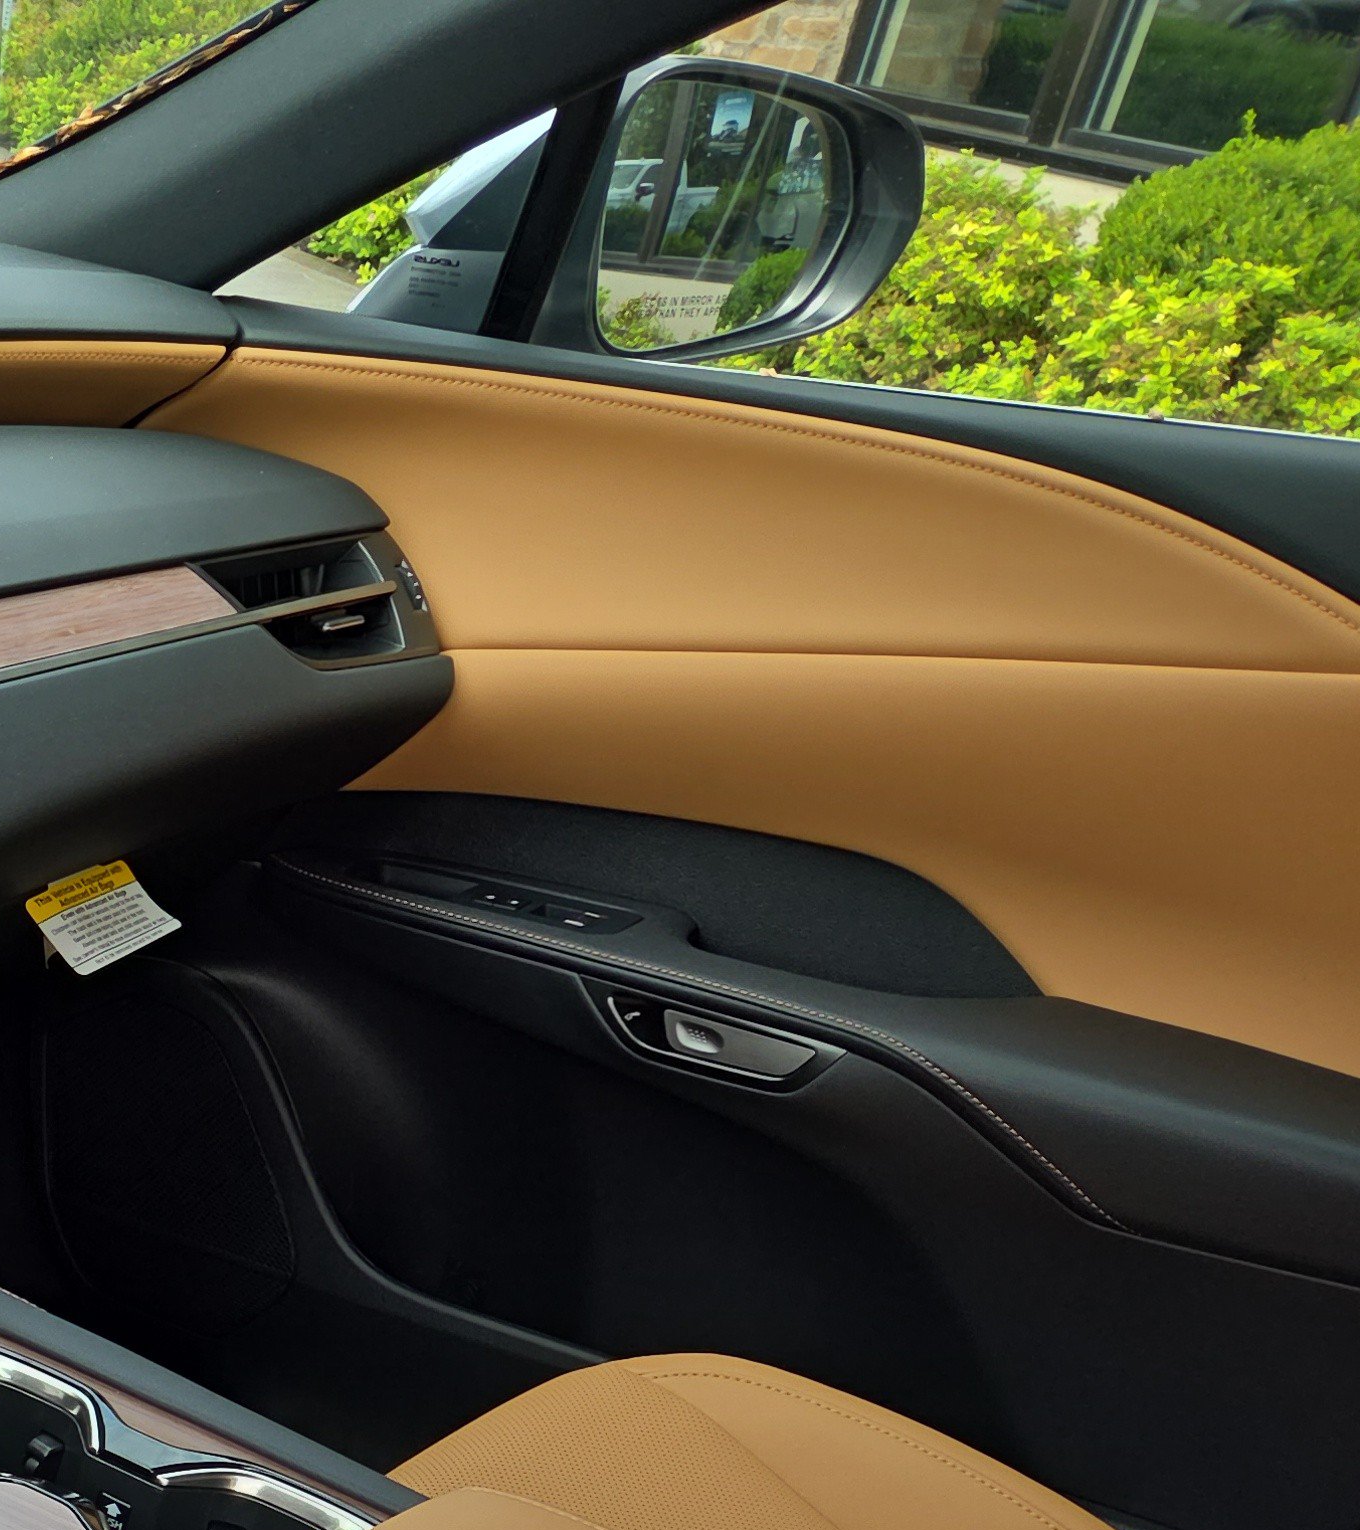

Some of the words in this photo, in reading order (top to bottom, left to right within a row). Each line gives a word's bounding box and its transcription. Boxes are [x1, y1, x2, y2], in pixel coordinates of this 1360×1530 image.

[680, 295, 713, 306] MIRROR
[680, 307, 701, 318] THEY
[35, 896, 52, 907] This
